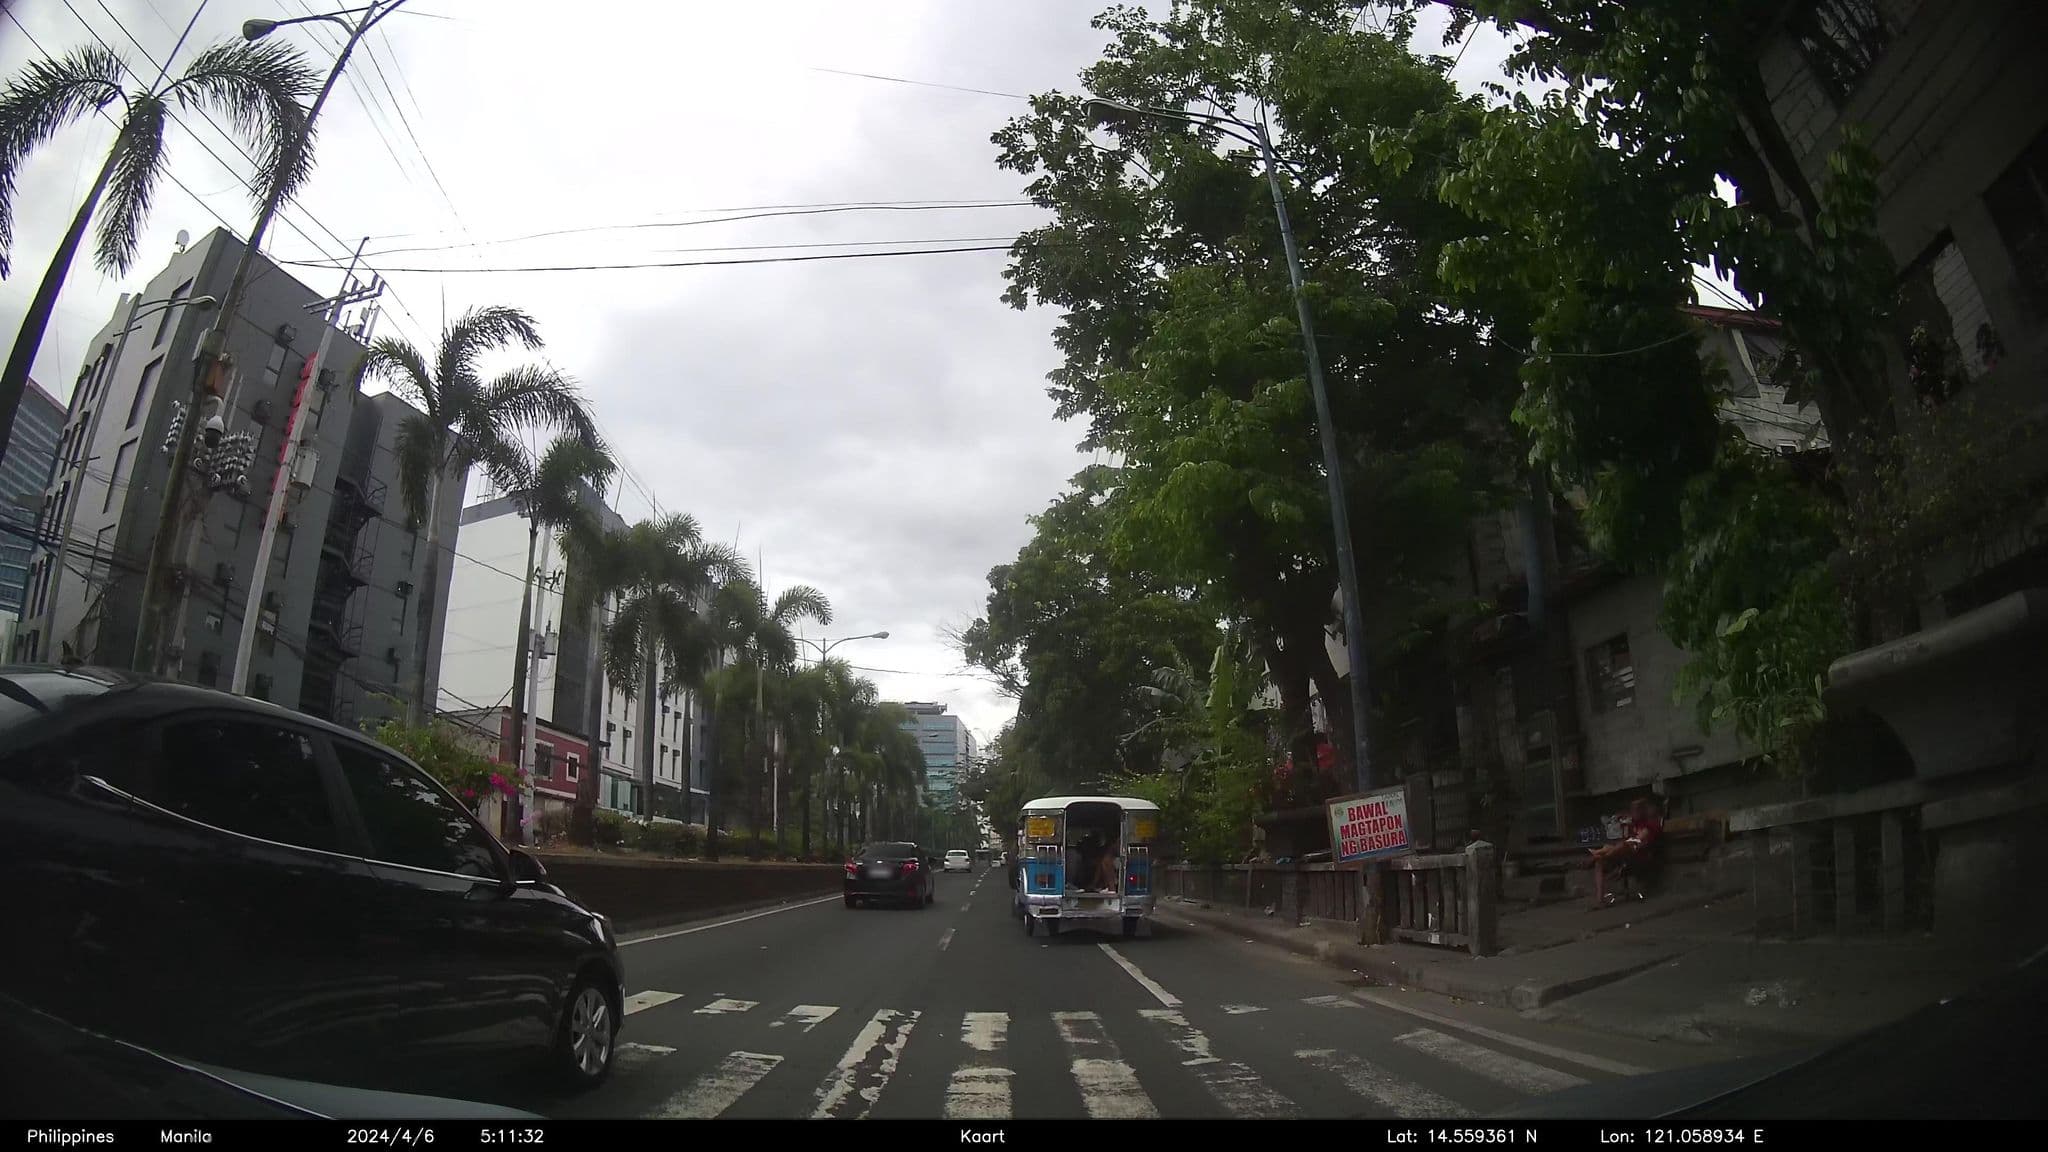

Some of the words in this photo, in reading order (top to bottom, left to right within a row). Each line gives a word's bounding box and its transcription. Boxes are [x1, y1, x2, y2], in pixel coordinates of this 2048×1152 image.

[1347, 801, 1388, 821] BAWAL
[1340, 814, 1403, 839] MAGTAPON
[1341, 840, 1357, 855] NG
[1360, 830, 1407, 851] BASURA
